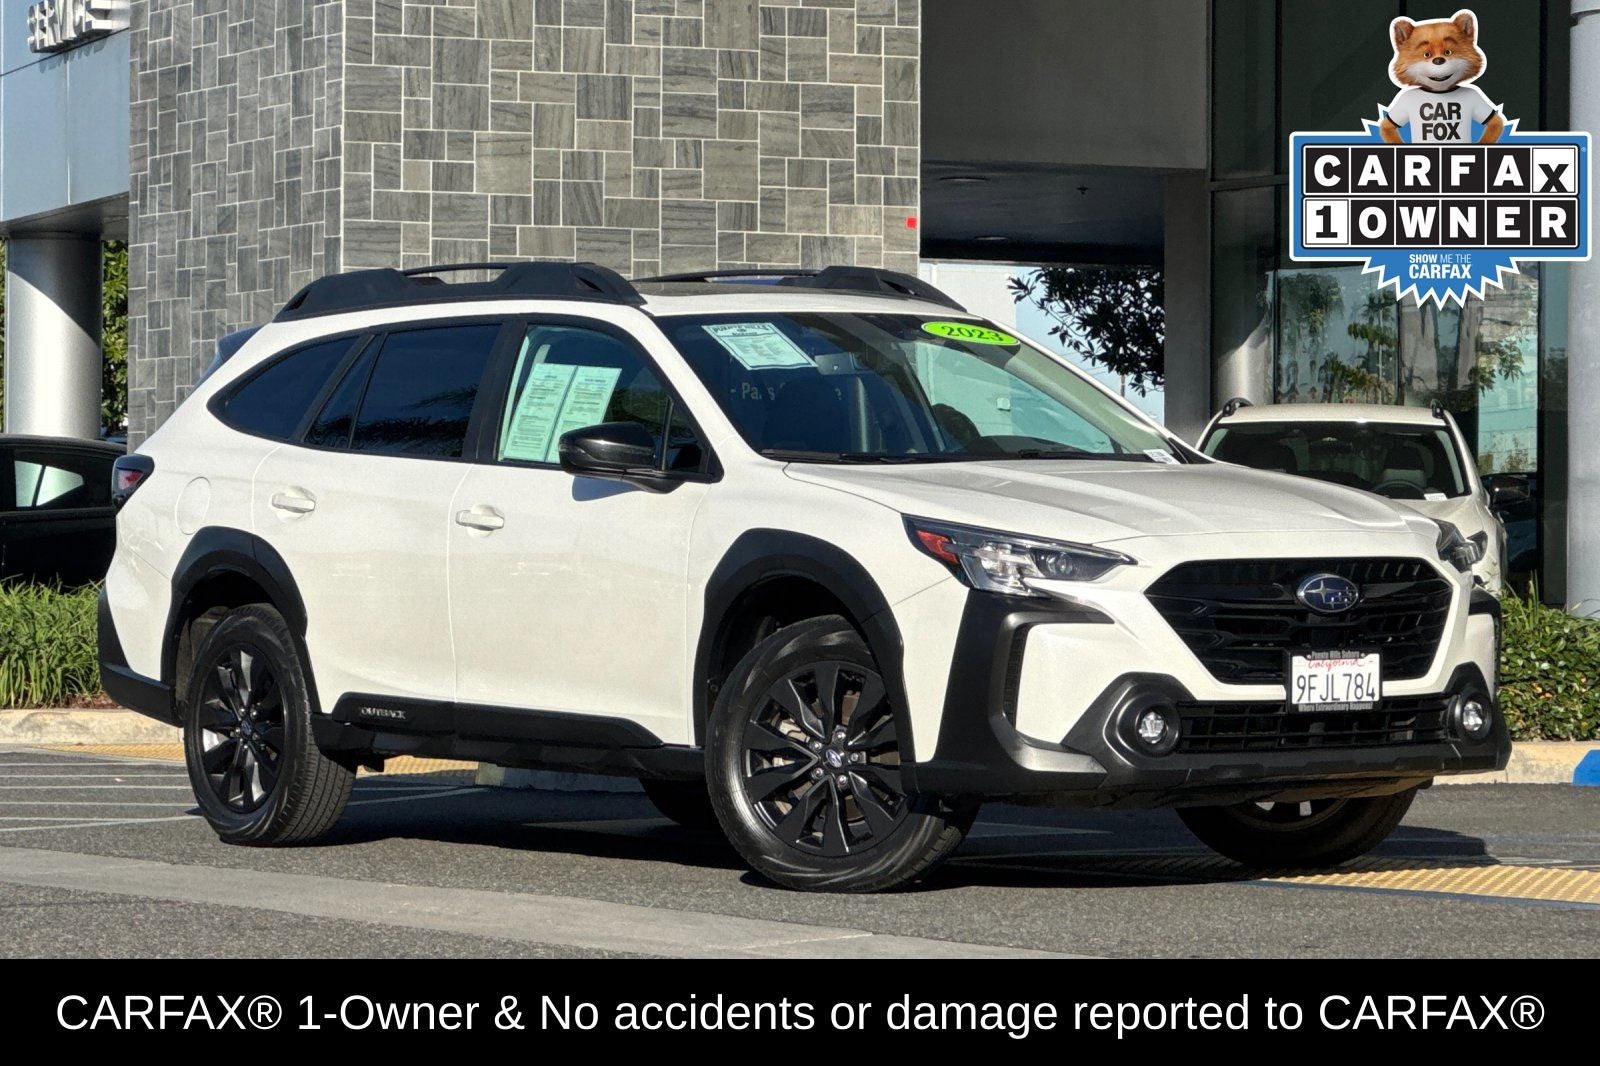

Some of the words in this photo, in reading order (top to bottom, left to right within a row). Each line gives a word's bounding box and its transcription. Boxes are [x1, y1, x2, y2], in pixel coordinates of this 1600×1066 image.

[941, 325, 1004, 342] 2023
[1296, 672, 1376, 703] 9FJL784
[361, 706, 406, 719] OUTBACK
